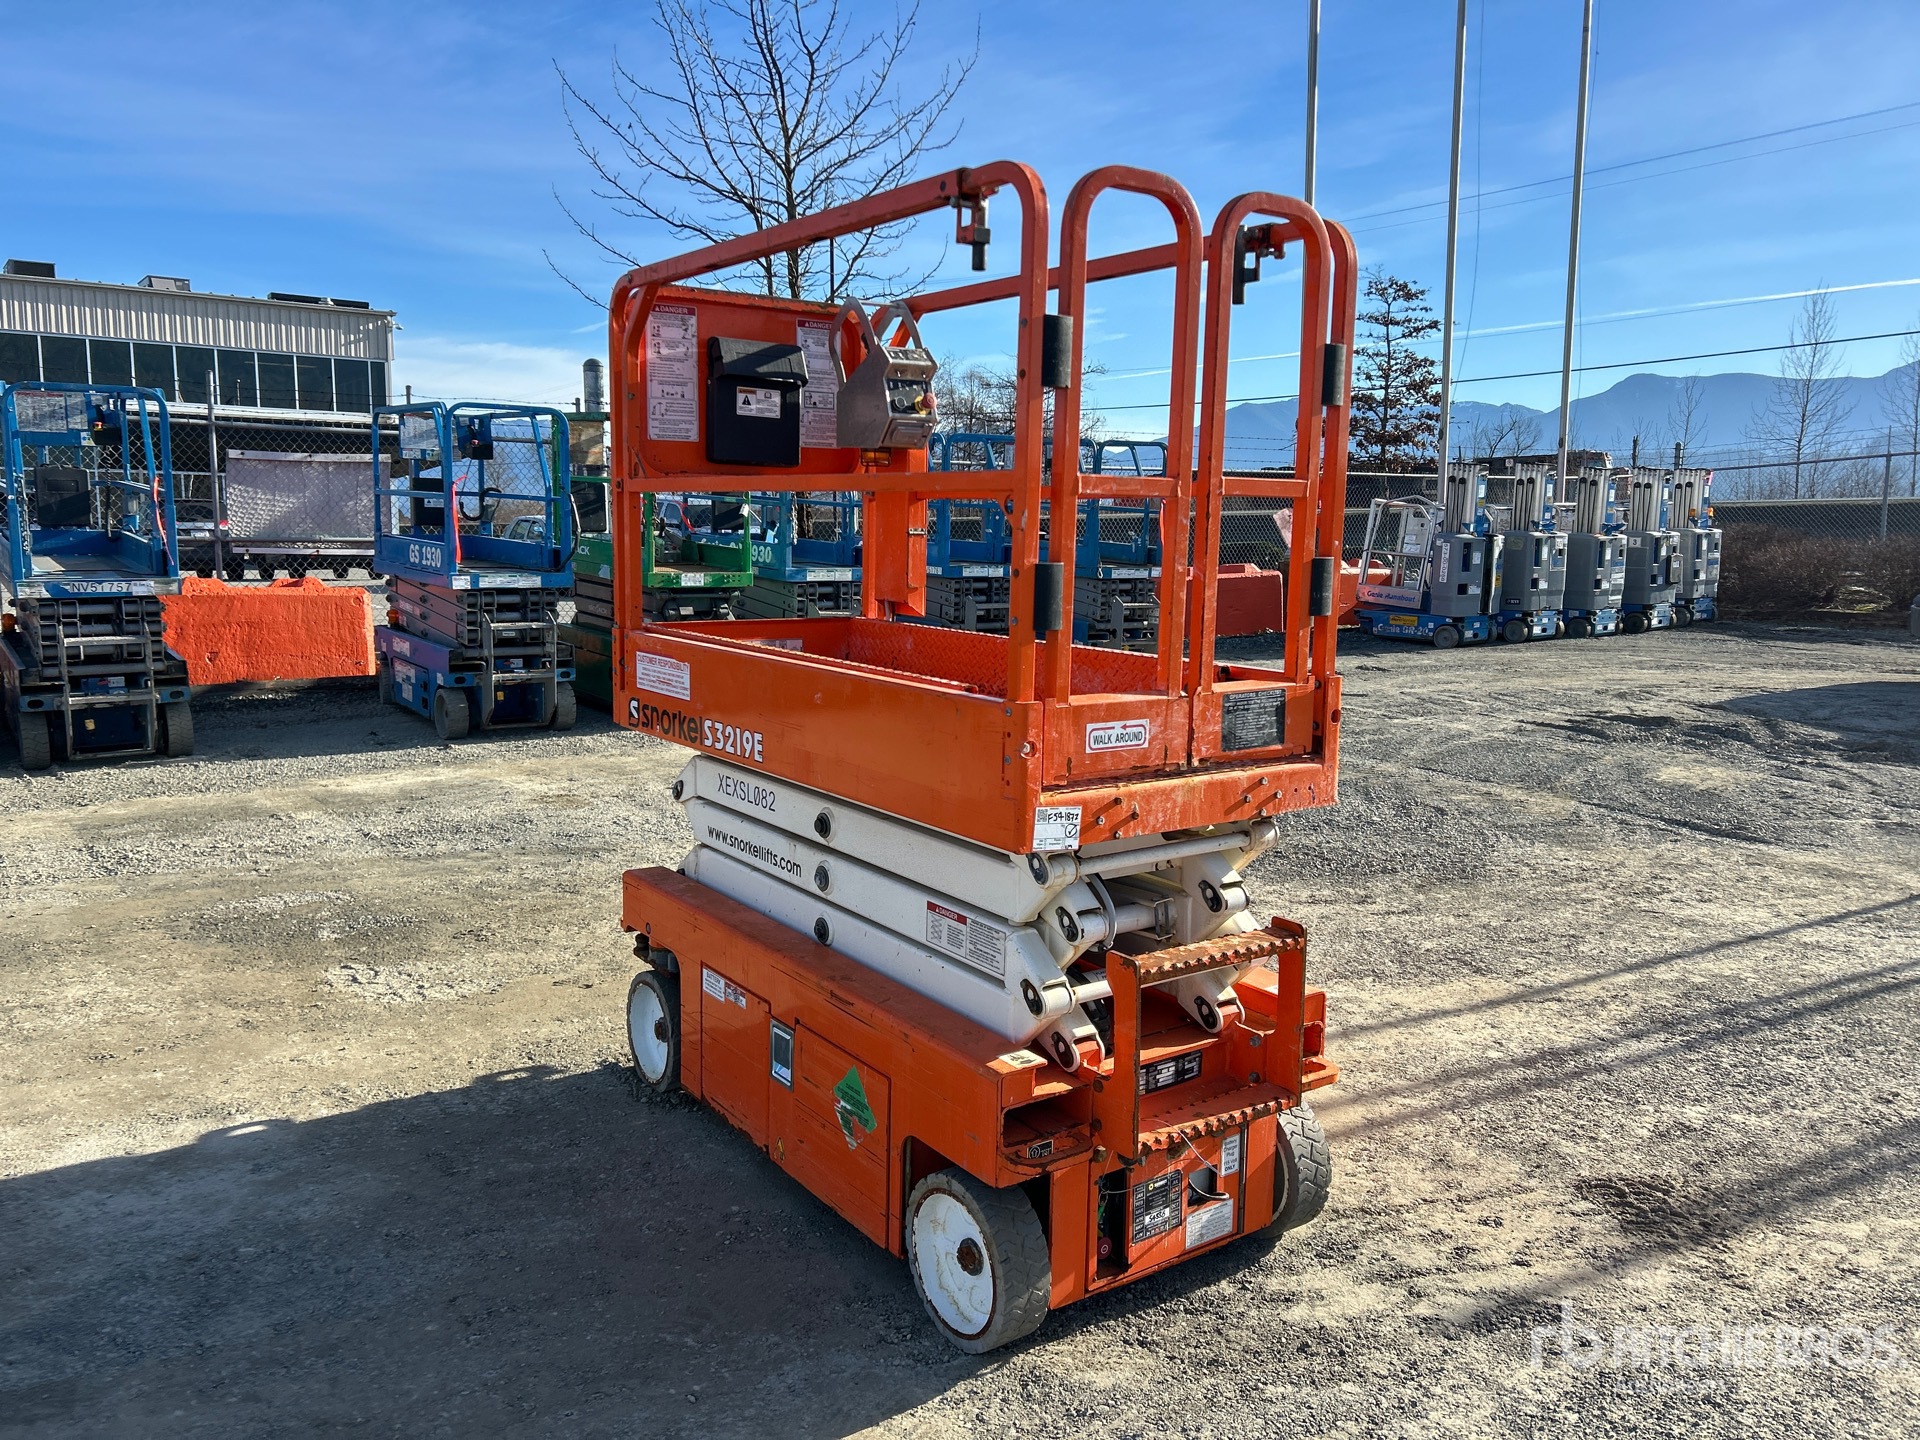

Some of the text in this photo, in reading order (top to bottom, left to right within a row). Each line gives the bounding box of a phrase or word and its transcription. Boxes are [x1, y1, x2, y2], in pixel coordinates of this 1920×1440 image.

[660, 306, 688, 314] DANGER
[409, 543, 441, 568] GS 1930
[751, 543, 772, 563] 930
[641, 705, 704, 746] snorkel
[703, 719, 764, 763] S3219E
[1092, 730, 1144, 746] WALK AROUND
[707, 824, 802, 878] www.snorkellifts.com
[939, 908, 958, 920] DANGER
[1225, 1164, 1236, 1172] ONLY
